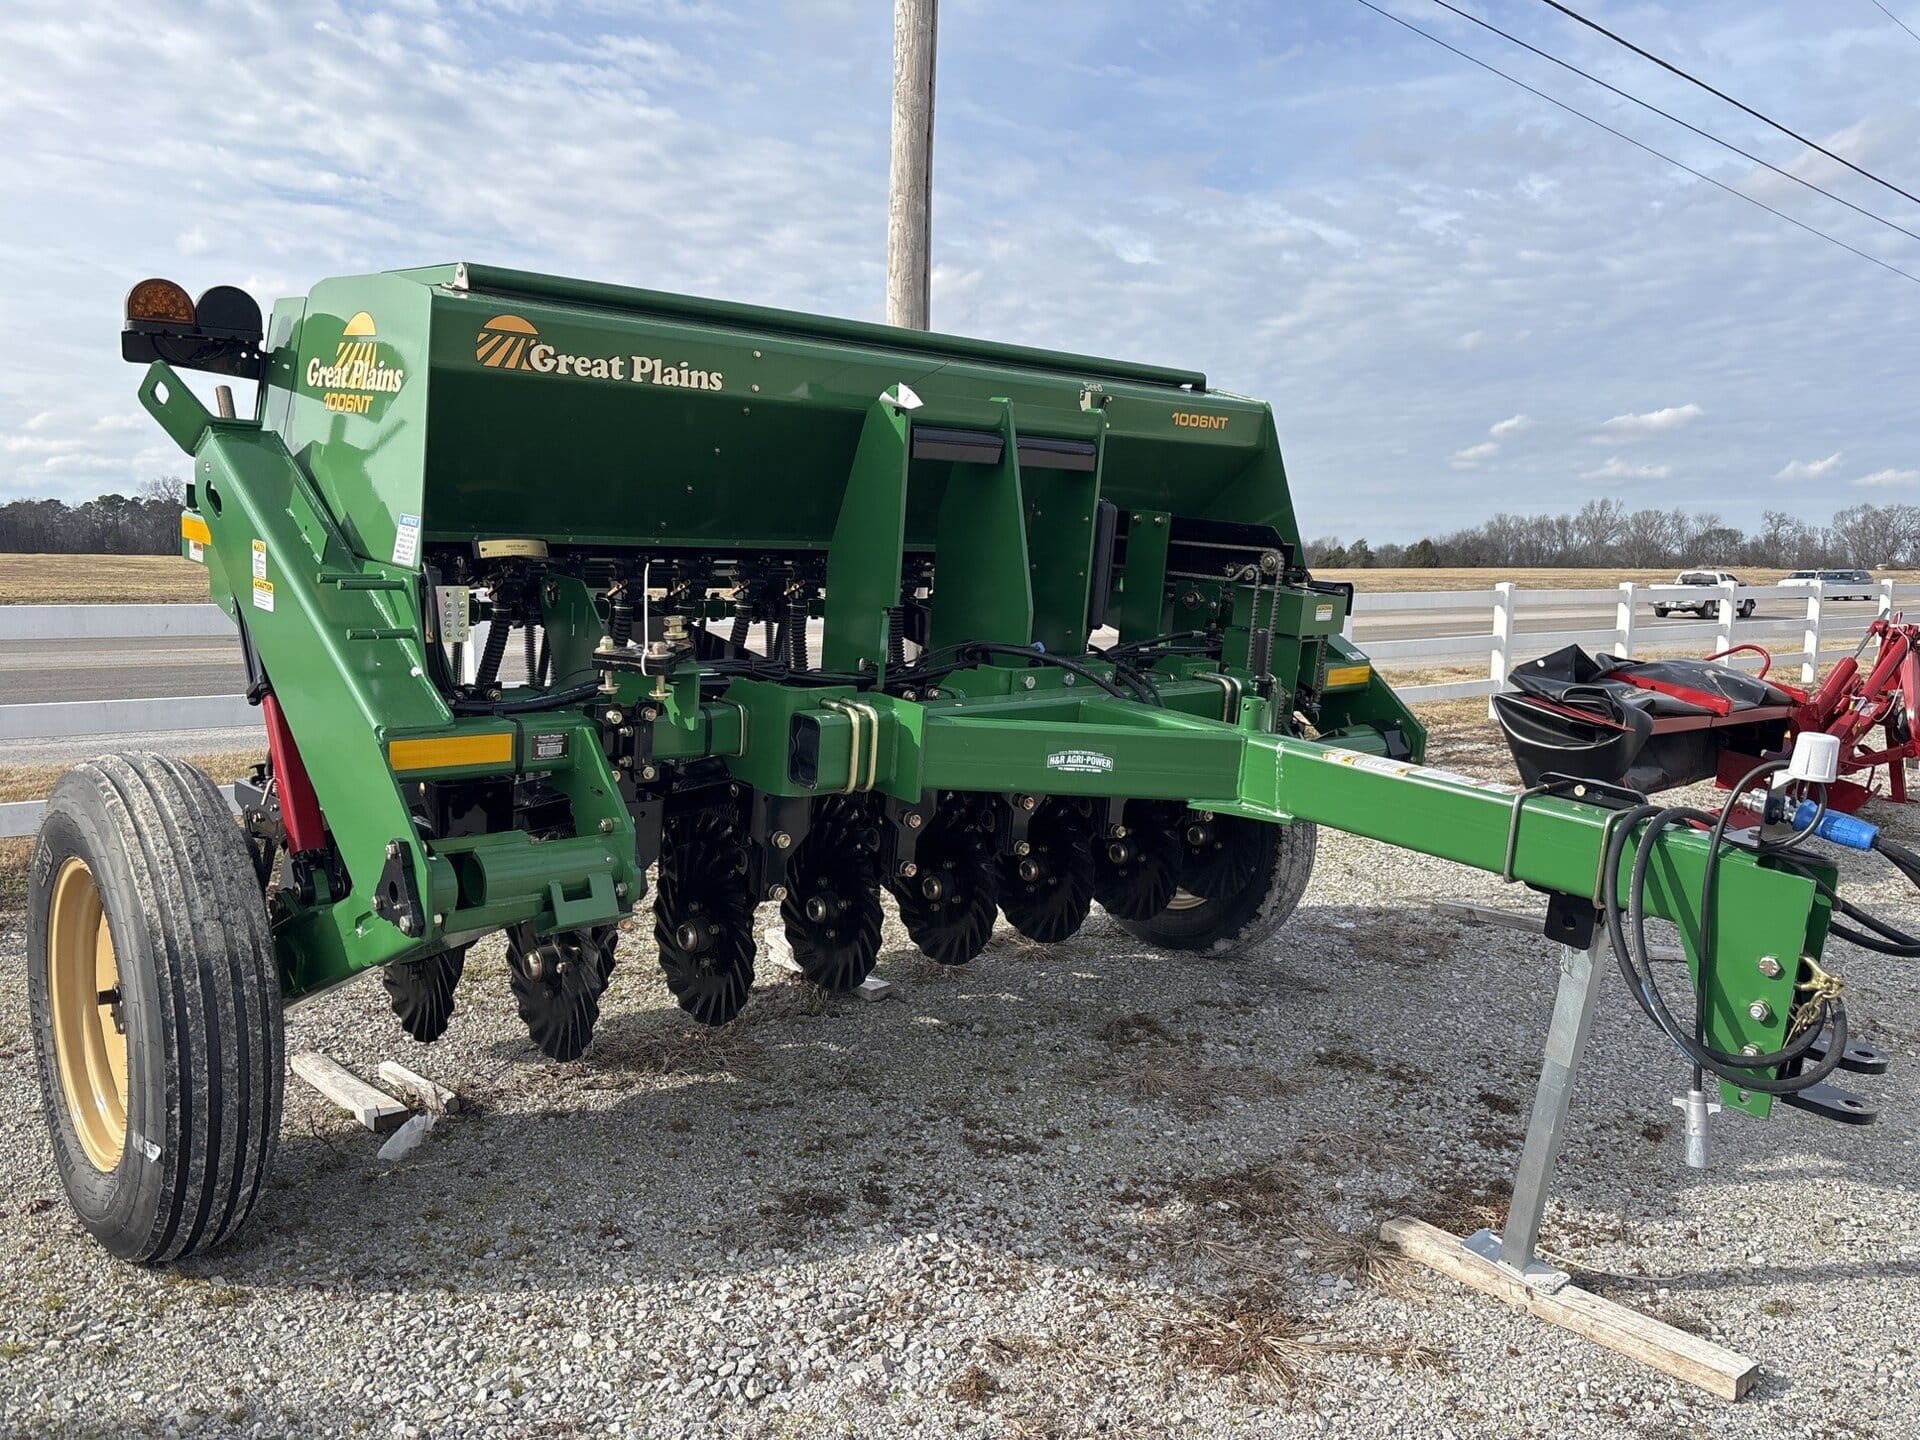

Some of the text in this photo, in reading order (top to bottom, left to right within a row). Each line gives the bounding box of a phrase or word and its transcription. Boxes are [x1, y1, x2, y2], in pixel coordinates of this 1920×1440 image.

[306, 357, 403, 393] Great Plains
[529, 343, 723, 391] Great Plains
[324, 392, 374, 414] 1006NT
[1172, 412, 1229, 429] 1006NT
[1049, 754, 1112, 768] H&R AGRI-POWER
